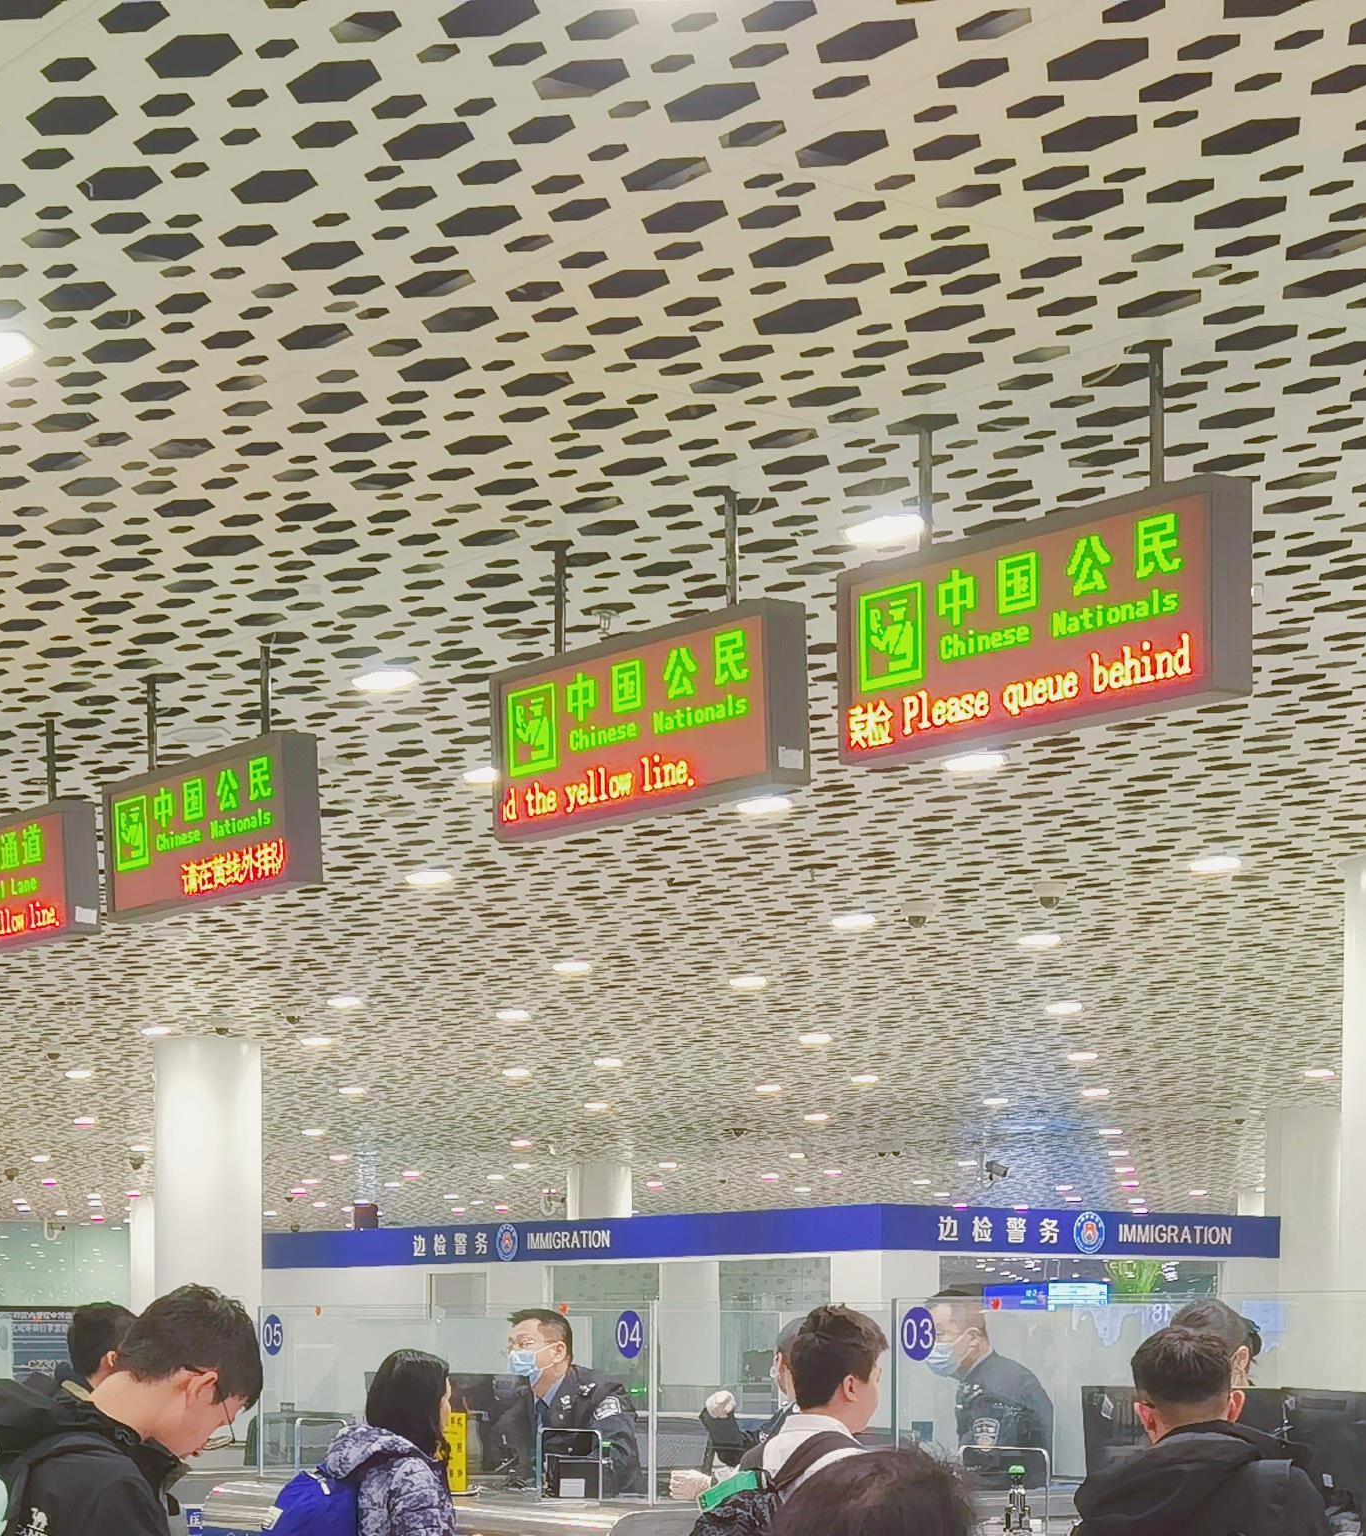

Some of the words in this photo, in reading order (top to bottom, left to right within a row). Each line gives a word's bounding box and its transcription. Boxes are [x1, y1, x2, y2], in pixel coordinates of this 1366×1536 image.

[937, 511, 1182, 628] 中国公民
[939, 623, 1032, 662] Chinese
[1051, 589, 1181, 639] Nationals
[565, 629, 751, 722] 中国公民
[902, 689, 990, 736] Please
[1002, 670, 1080, 716] queue
[1090, 632, 1192, 695] behind
[568, 720, 638, 752] Chinese
[651, 693, 749, 735] Nationals
[153, 756, 273, 828] 中国公民
[525, 781, 558, 817] the
[565, 766, 633, 813] yellow
[640, 754, 695, 792] line.
[156, 829, 203, 852] Chinese
[210, 808, 273, 840] Nationals
[10, 876, 39, 896] Lane
[413, 1231, 488, 1257] 边检警务
[527, 1230, 611, 1250] IMMIGRATION
[938, 1215, 1060, 1244] 边检警务
[1118, 1223, 1232, 1245] IMMIGRATION
[264, 1324, 282, 1346] 05
[617, 1325, 643, 1349] 04
[904, 1318, 933, 1349] 03
